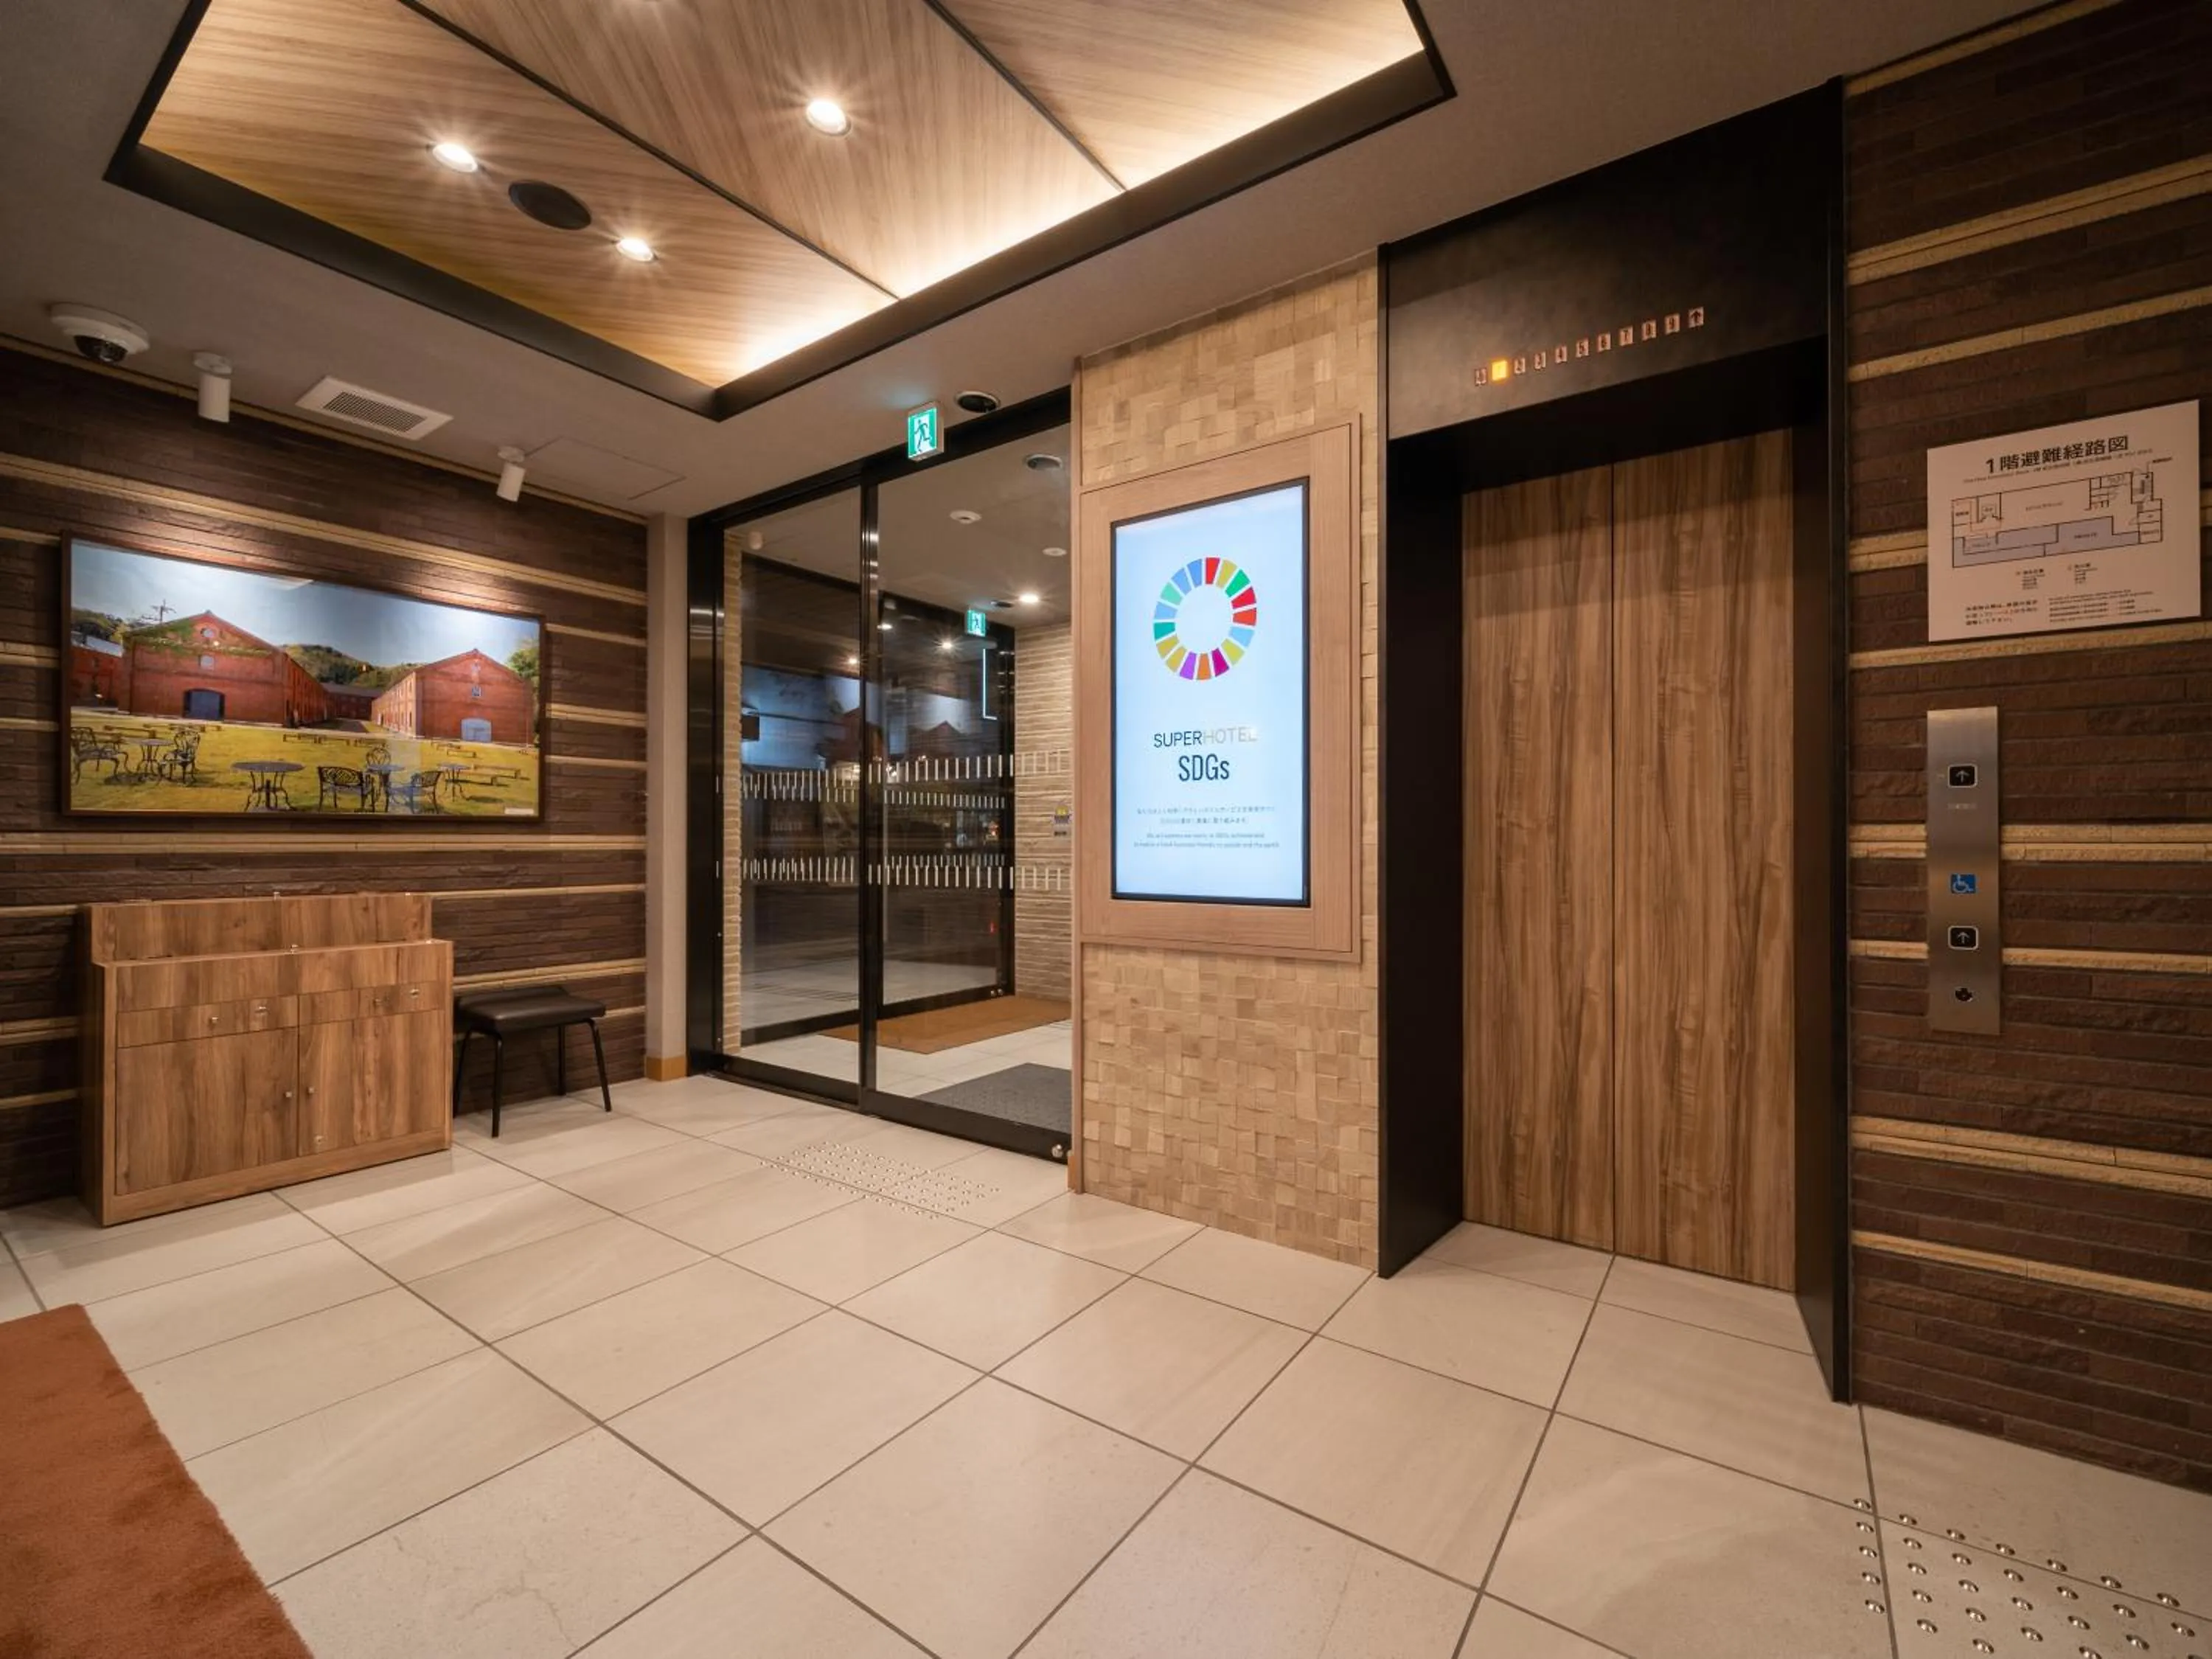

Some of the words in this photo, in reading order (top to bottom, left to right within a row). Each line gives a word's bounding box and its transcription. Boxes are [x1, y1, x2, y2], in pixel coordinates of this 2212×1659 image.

[1986, 435, 2129, 473] 1階避難経路図
[1178, 753, 1230, 782] SDGs
